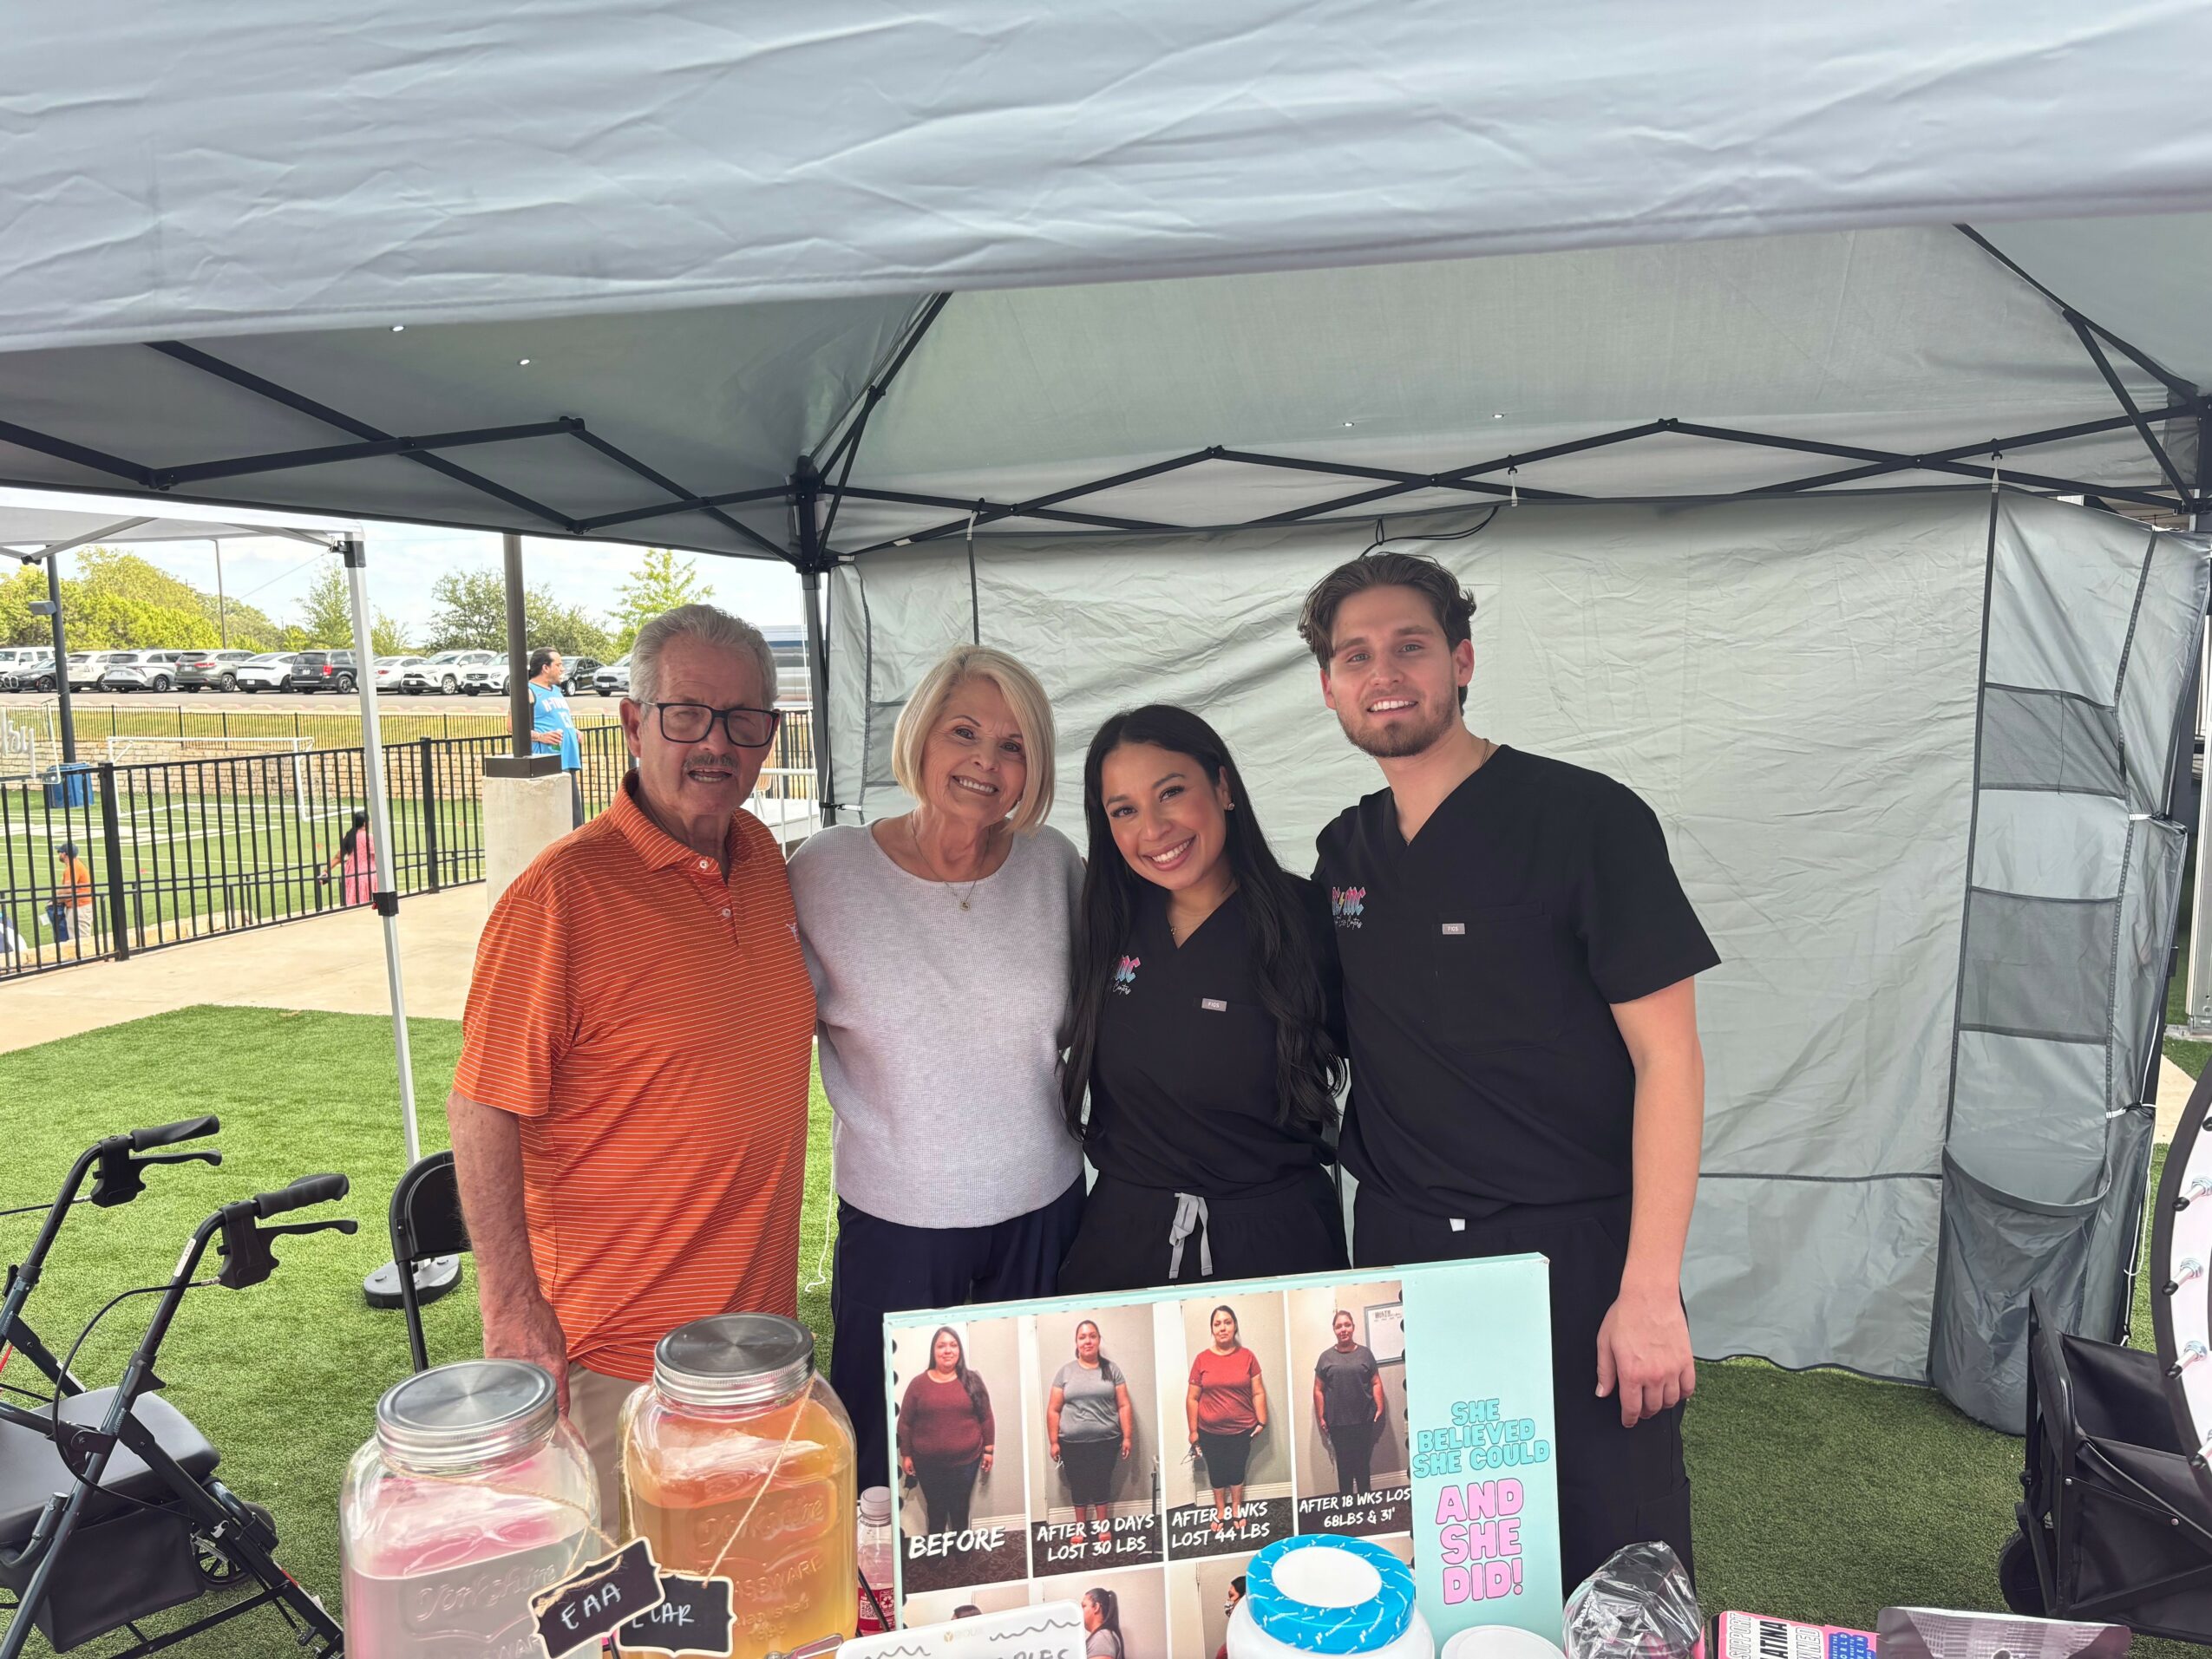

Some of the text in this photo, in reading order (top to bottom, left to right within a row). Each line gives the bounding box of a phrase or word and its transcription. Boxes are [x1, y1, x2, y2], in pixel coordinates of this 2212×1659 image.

[1451, 1398, 1500, 1426] SHE
[1417, 1418, 1535, 1453] BELIEVED
[1412, 1440, 1550, 1478] SHE COULD
[1172, 1501, 1267, 1527] AFTER 8 WKS
[1299, 1487, 1412, 1513] AFTER 18 WKS LOS
[1436, 1478, 1523, 1525] AND
[1037, 1514, 1155, 1542] AFTER 30 DAYS
[1324, 1512, 1364, 1527] 68LBS
[1367, 1510, 1377, 1524] &
[908, 1525, 1005, 1559] BEFORE
[1048, 1536, 1147, 1561] LOST 30 LBS
[1172, 1523, 1270, 1548] LOST 44 LBS
[1440, 1518, 1522, 1564] SHE
[1443, 1558, 1522, 1604] DID!
[1759, 1620, 1789, 1659] ATINA
